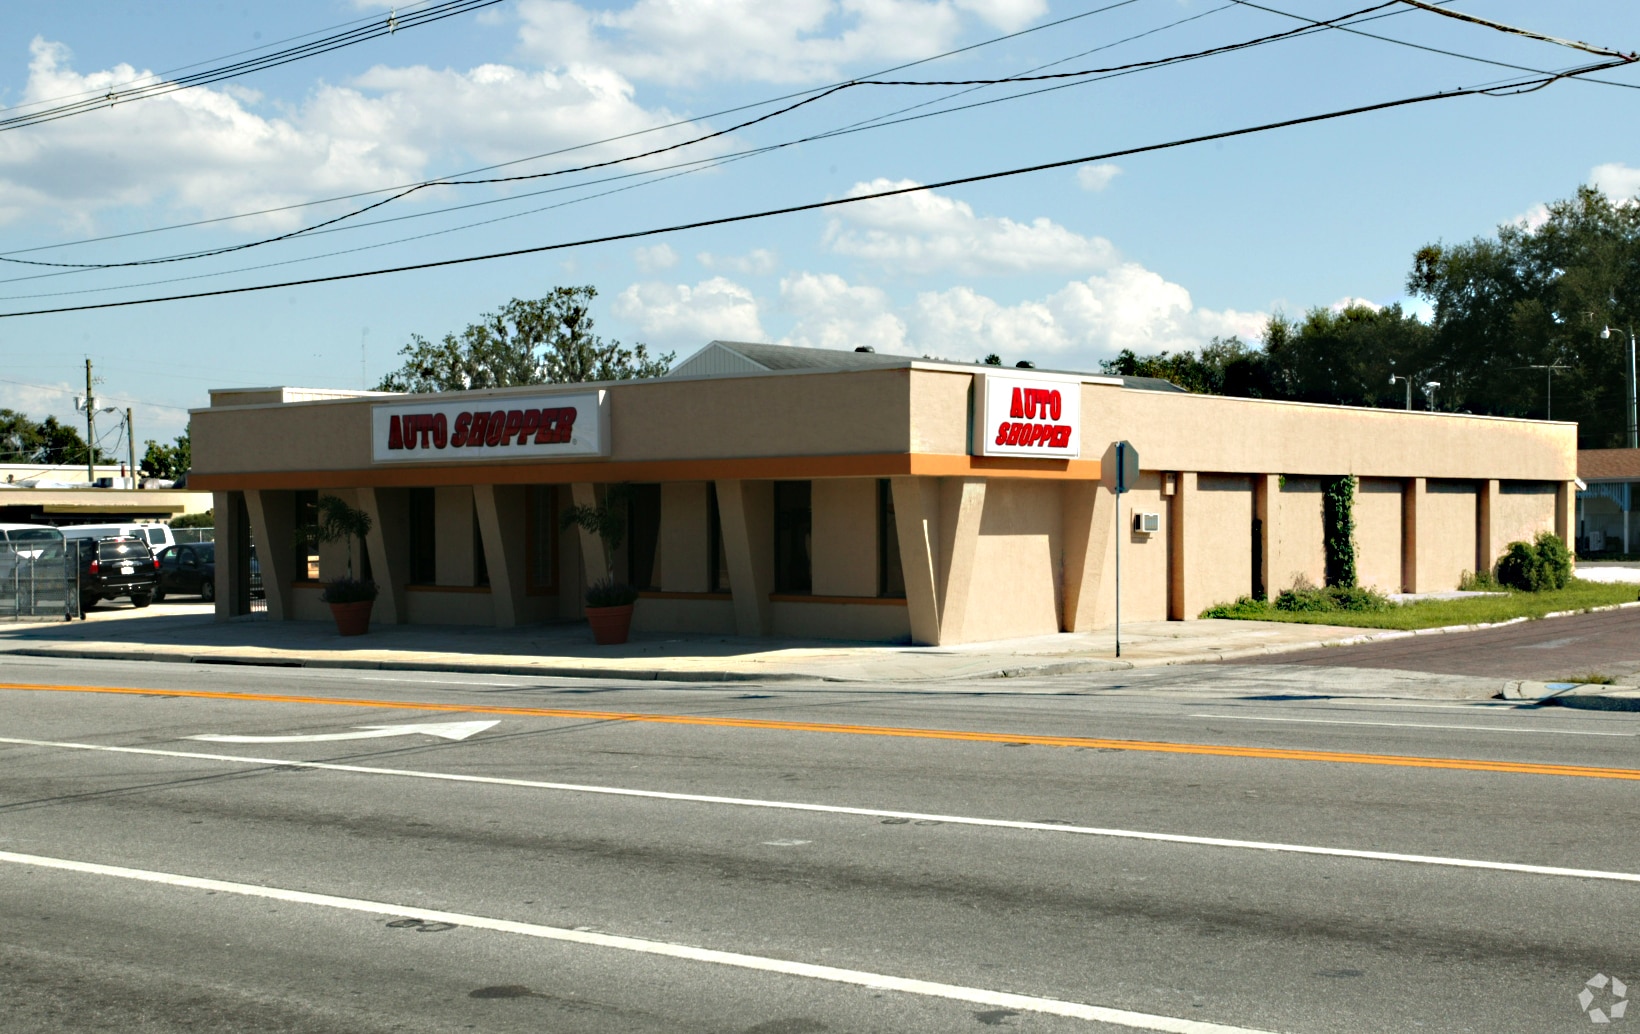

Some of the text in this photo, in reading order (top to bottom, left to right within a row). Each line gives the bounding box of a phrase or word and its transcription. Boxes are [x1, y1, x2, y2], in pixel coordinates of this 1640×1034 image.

[1010, 386, 1062, 421] AUTO
[388, 406, 577, 450] AUTO SHOPPER
[995, 421, 1072, 448] SHOPPER
